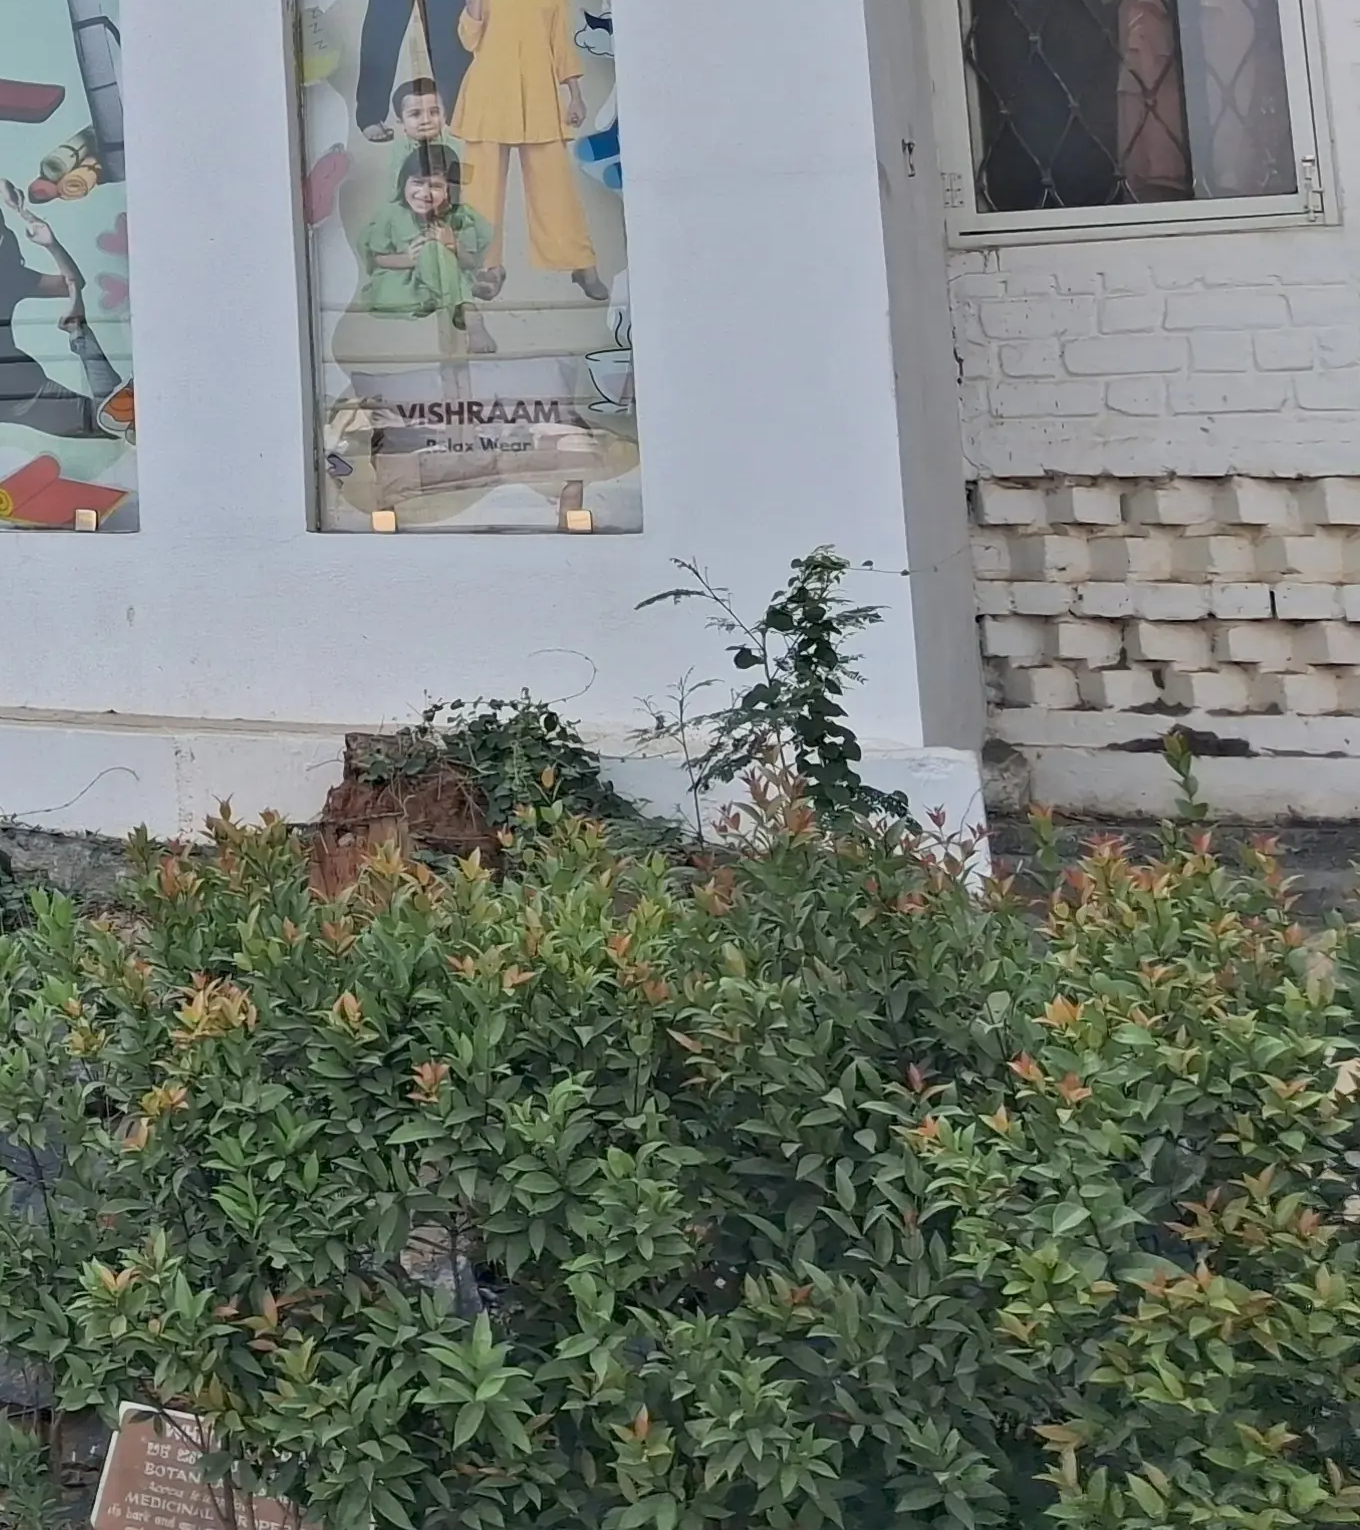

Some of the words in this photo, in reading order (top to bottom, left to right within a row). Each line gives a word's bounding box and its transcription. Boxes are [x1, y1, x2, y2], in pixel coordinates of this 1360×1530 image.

[396, 400, 562, 427] VISHRAAM
[479, 437, 532, 453] Wear
[124, 1491, 214, 1521] MEDICINAL
